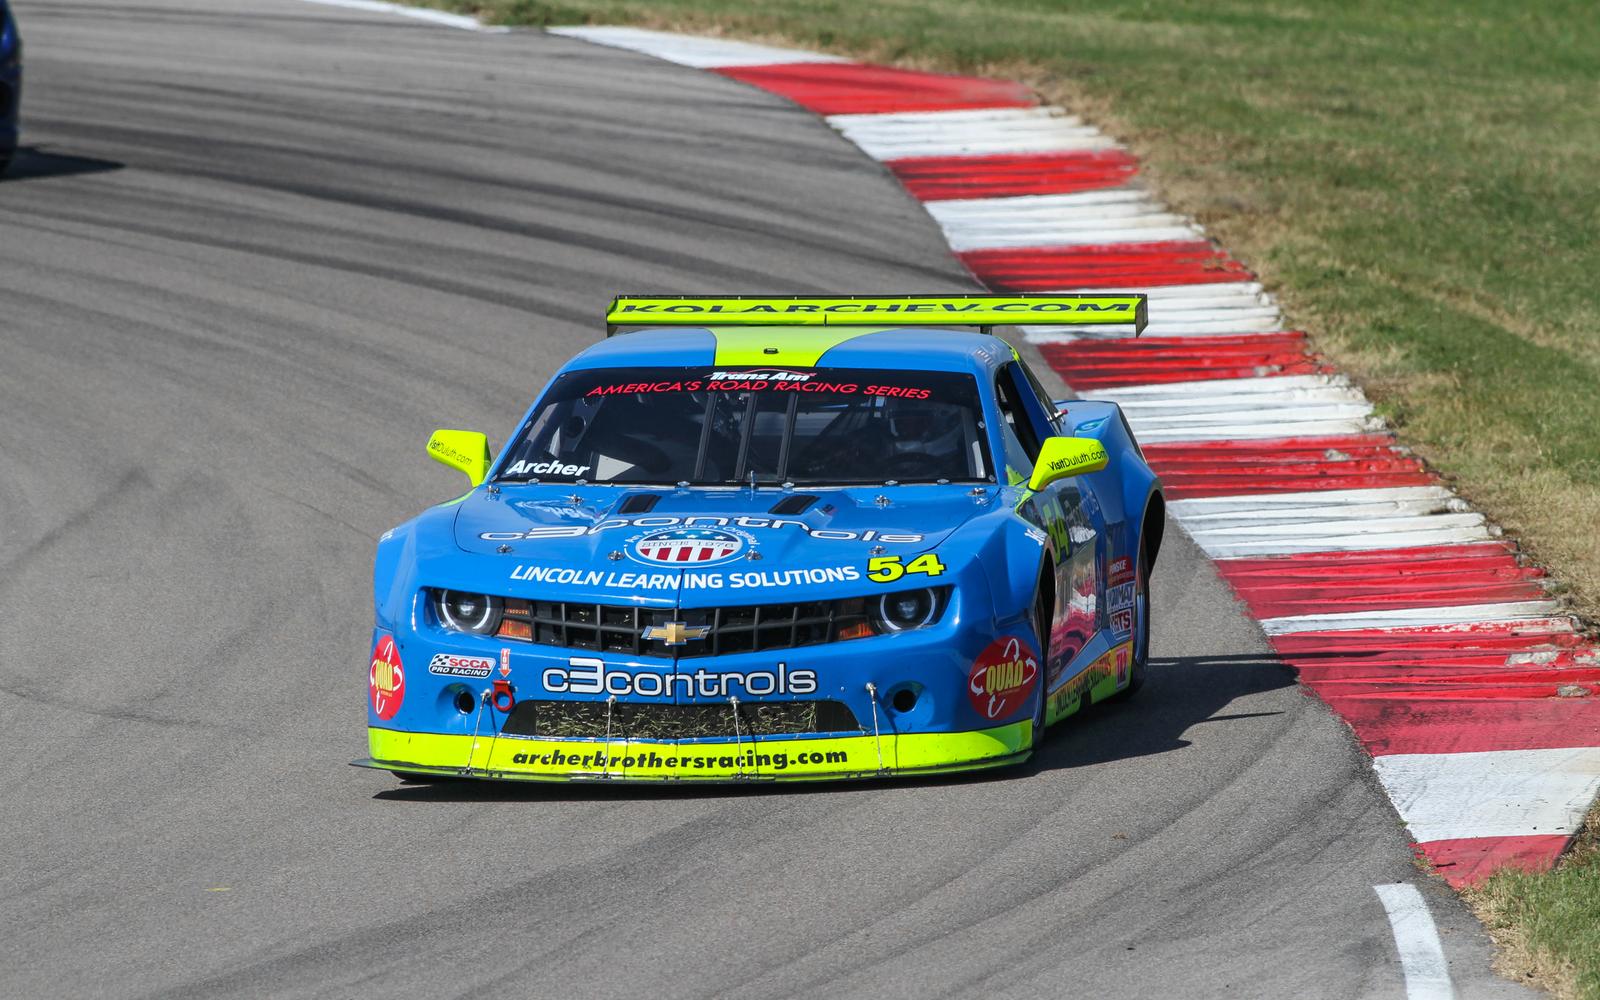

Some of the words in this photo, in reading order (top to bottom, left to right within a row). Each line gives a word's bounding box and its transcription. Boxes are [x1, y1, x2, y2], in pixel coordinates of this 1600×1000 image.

[621, 303, 1131, 313] KOLARCHEV.COM
[586, 381, 703, 397] AMERICA'S
[706, 380, 770, 392] ROAD
[773, 381, 859, 394] RACING
[863, 384, 932, 400] SERIES
[506, 459, 591, 477] Archer
[510, 565, 605, 586] LINCOLN
[605, 570, 724, 590] LEARNING
[729, 564, 861, 588] SOLUTIONS
[866, 553, 946, 583] 54
[431, 666, 450, 674] PRO
[452, 667, 489, 677] RACING
[449, 657, 490, 669] SCCA
[375, 659, 393, 691] QUAD
[541, 656, 818, 698] c3controls
[985, 659, 1025, 696] QUAD
[512, 749, 848, 770] archerbrothersracing.com
